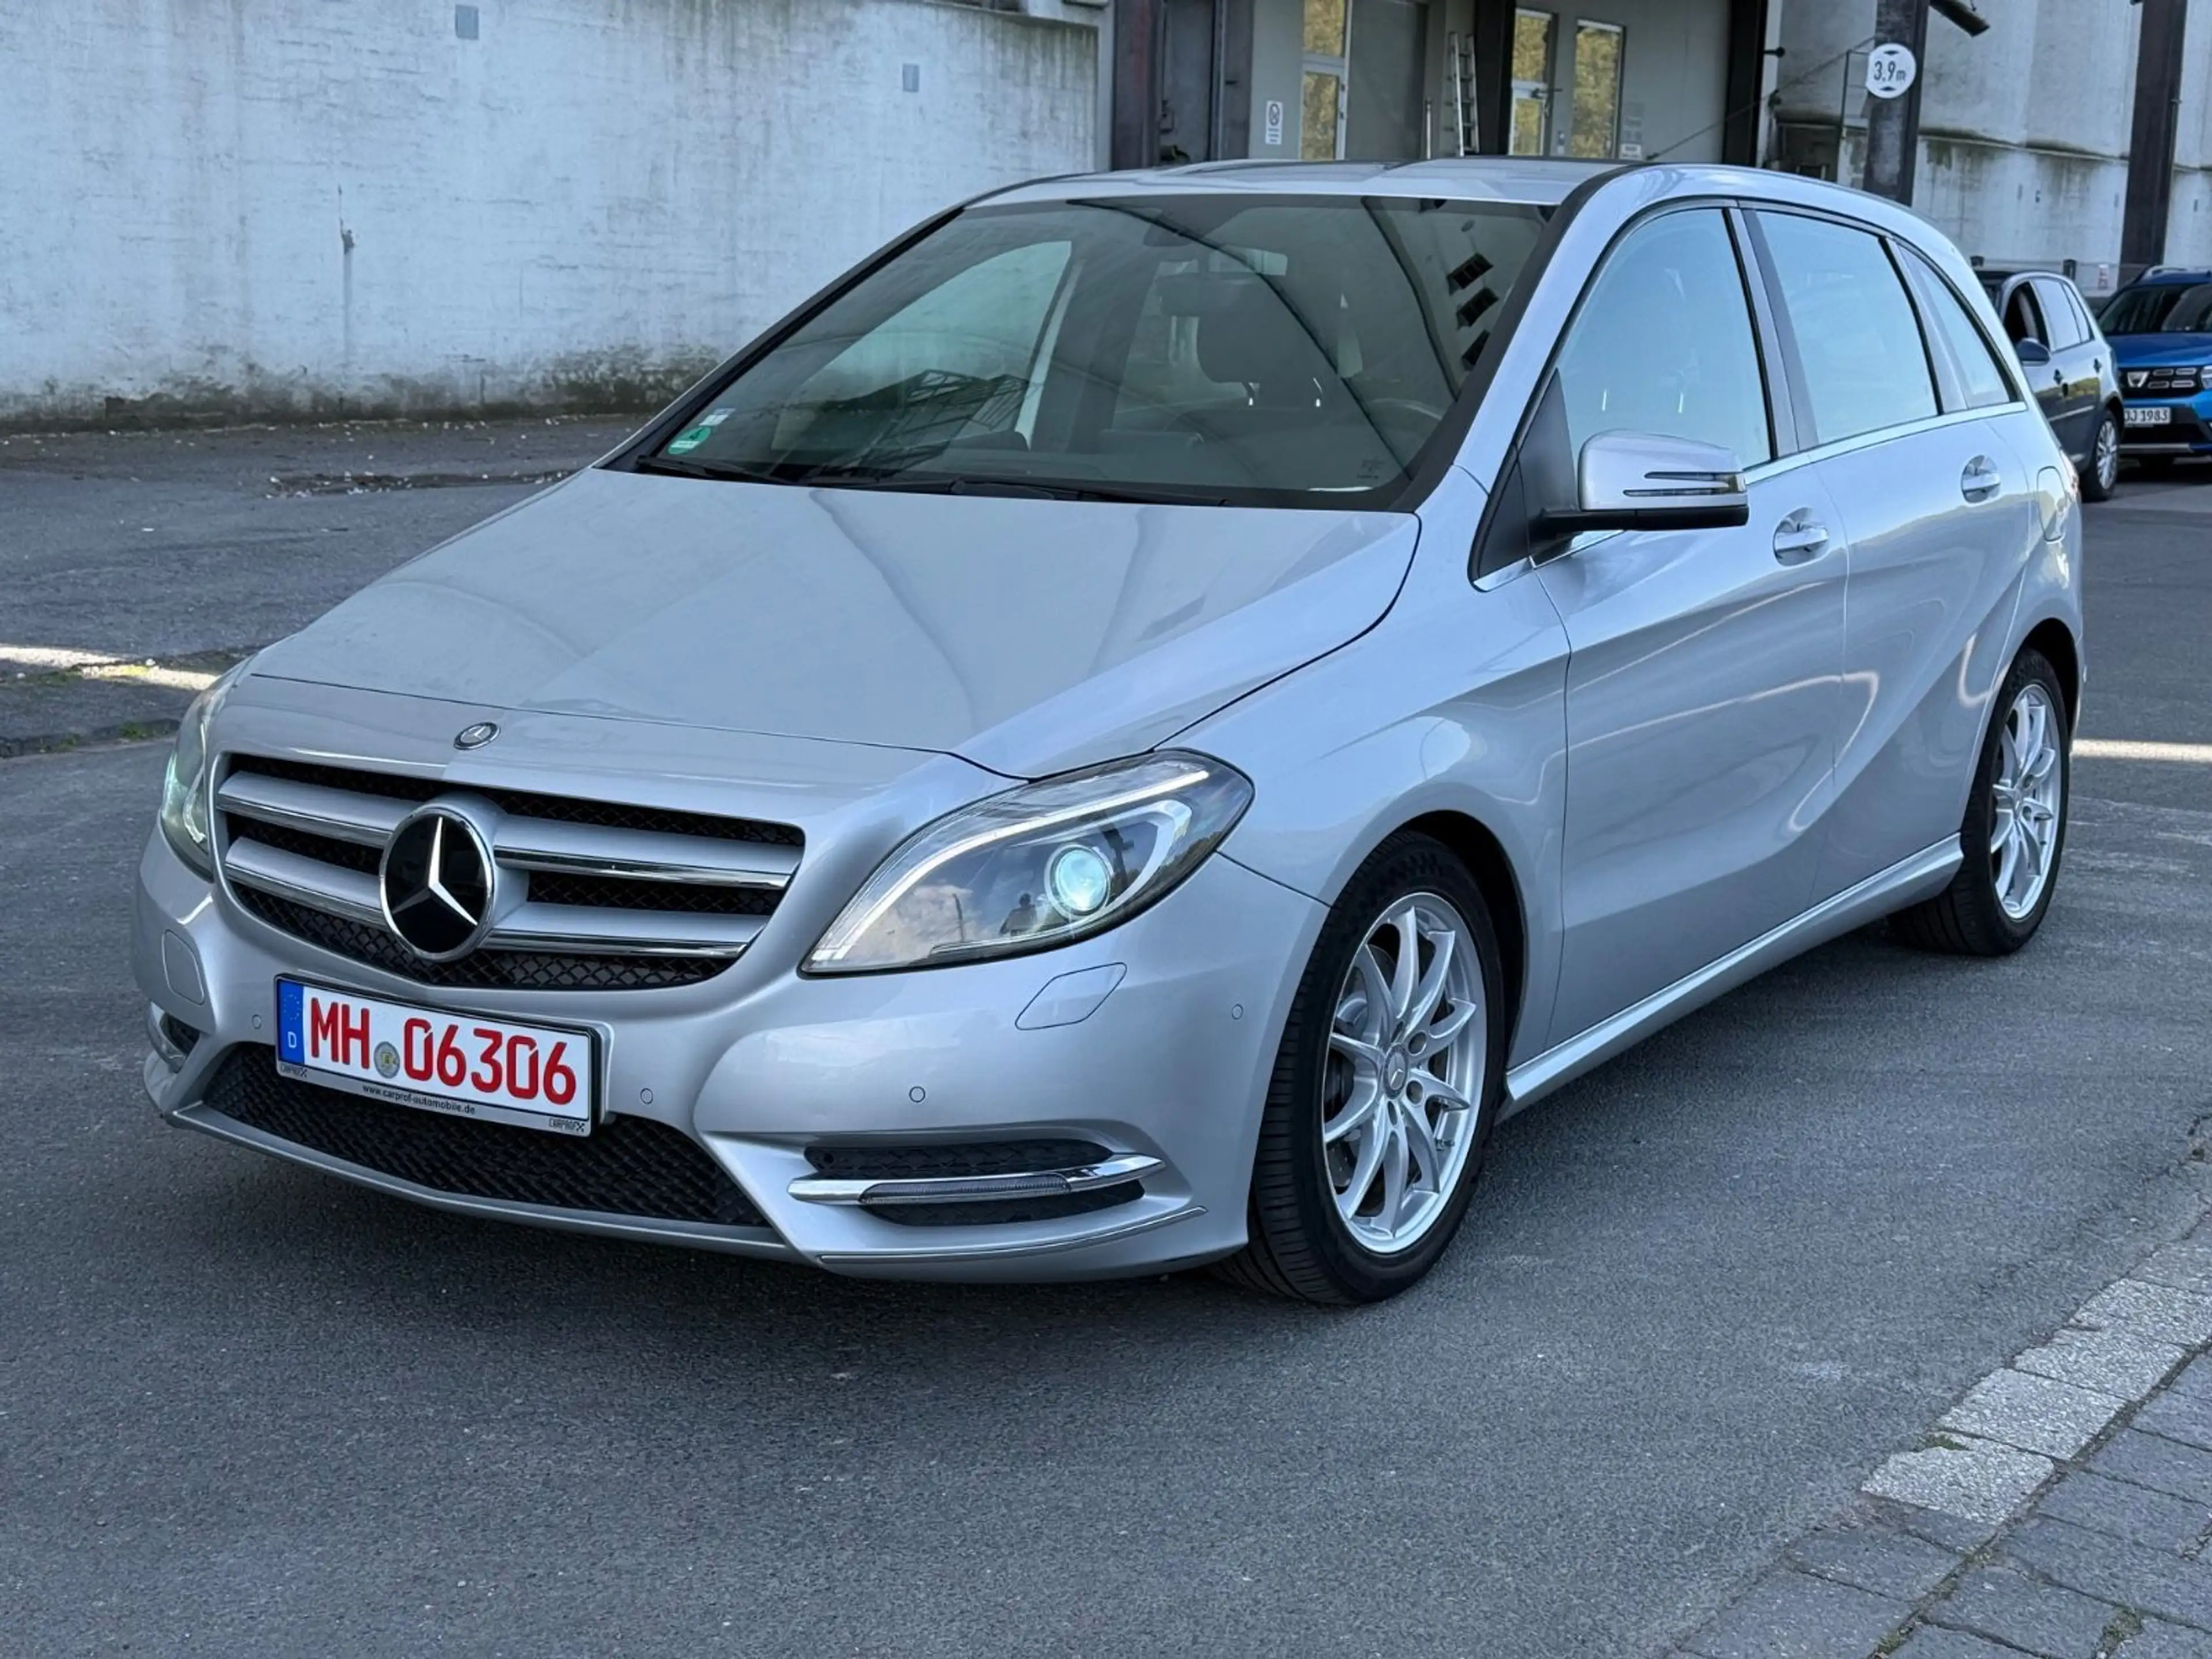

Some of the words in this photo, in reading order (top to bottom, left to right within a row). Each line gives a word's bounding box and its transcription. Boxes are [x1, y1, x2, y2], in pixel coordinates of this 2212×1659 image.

[2140, 409, 2167, 421] 1983
[288, 1031, 297, 1048] D
[311, 997, 370, 1069] MH
[404, 1017, 576, 1105] 06306
